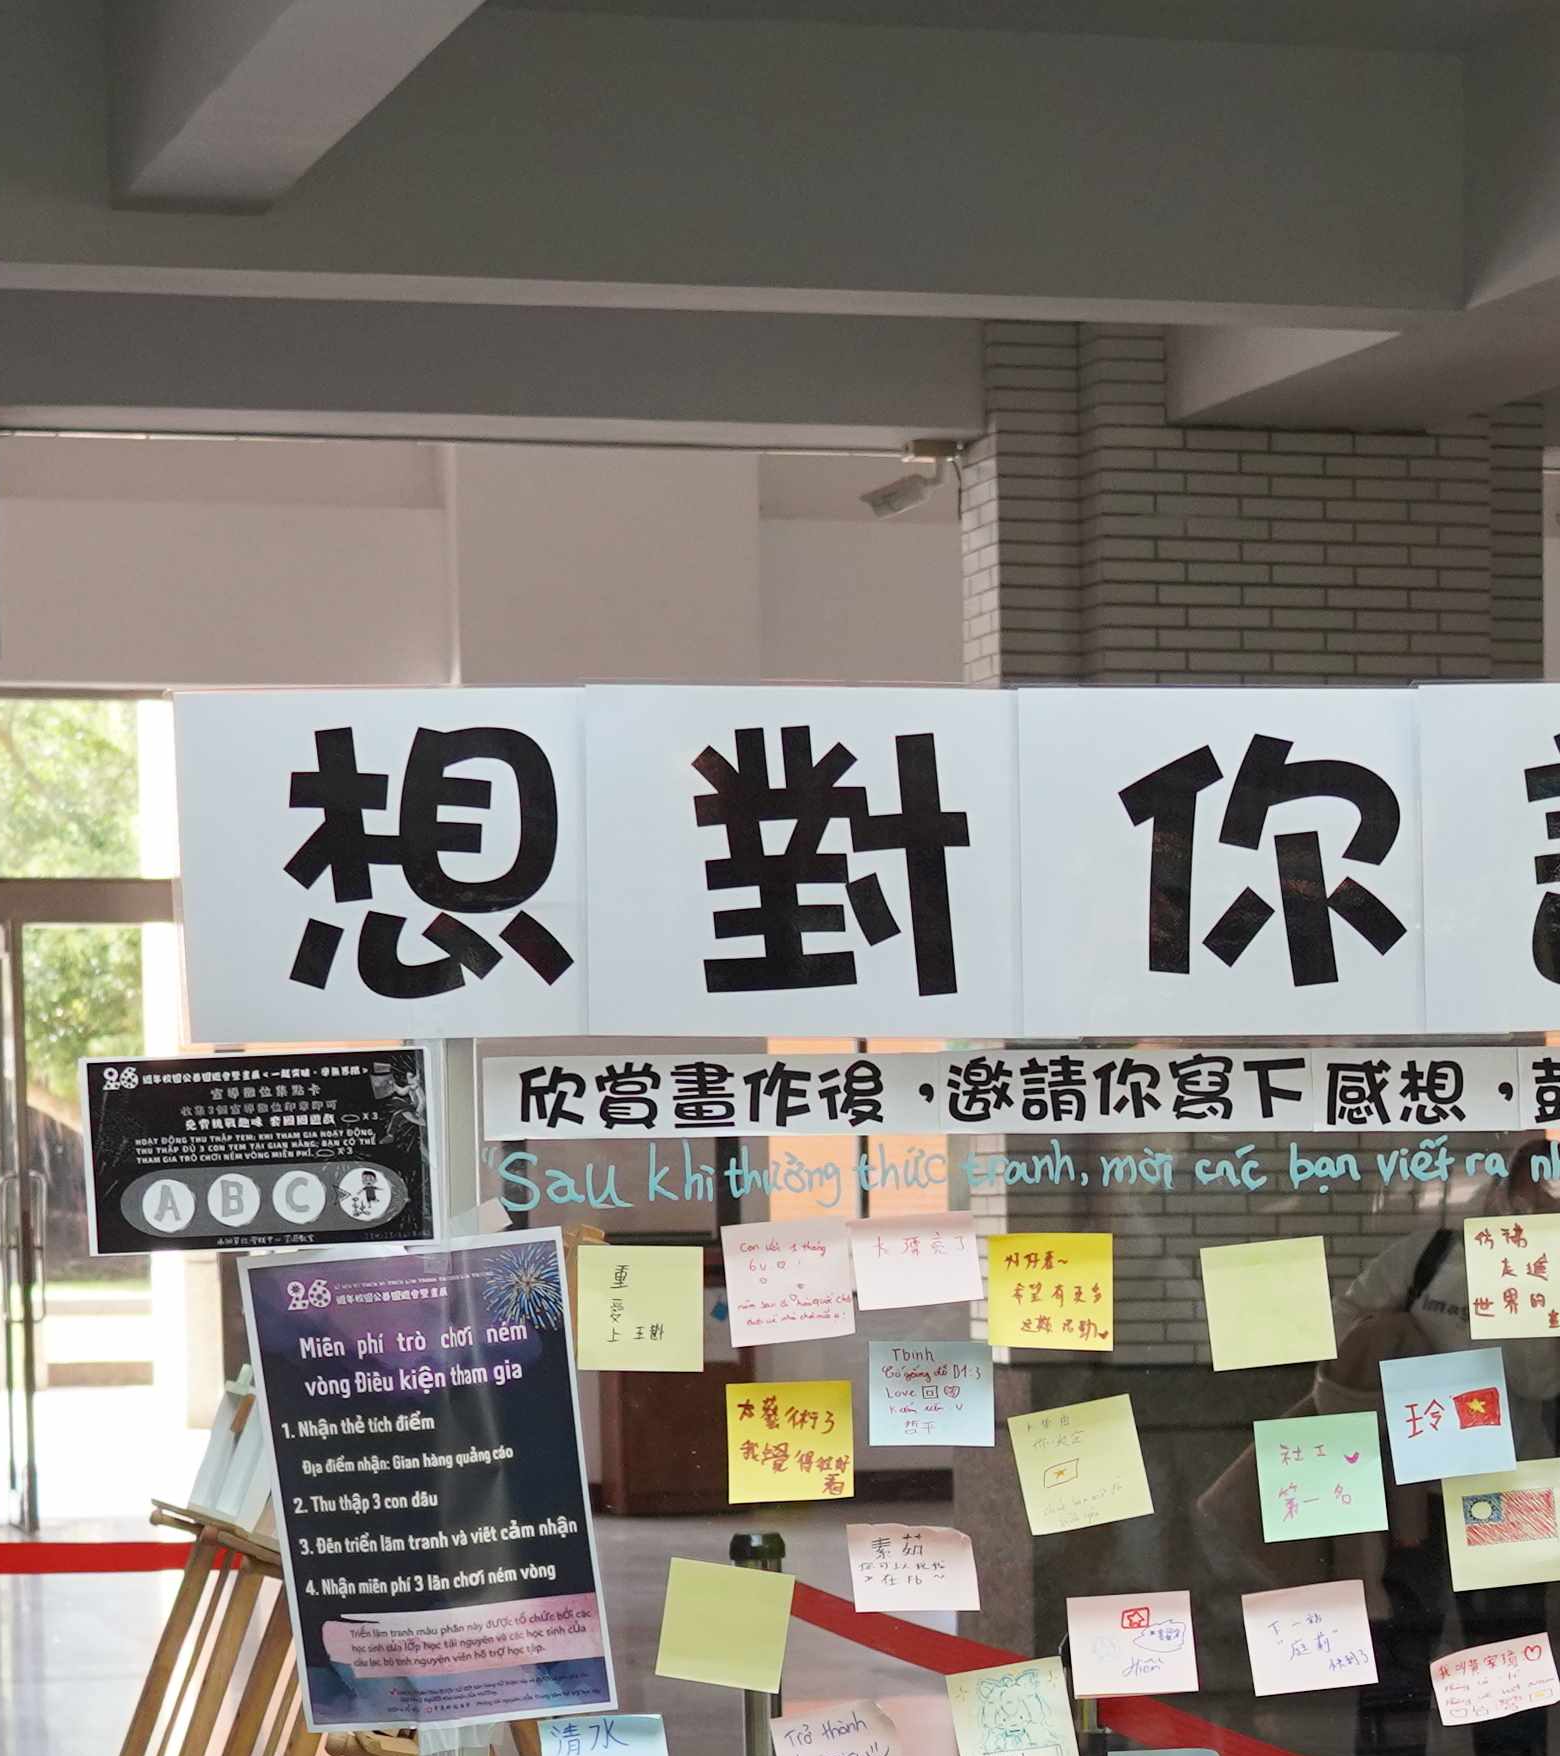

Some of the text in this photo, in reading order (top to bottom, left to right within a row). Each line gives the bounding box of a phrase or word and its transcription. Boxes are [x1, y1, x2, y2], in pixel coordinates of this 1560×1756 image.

[648, 1141, 716, 1202] khi
[154, 1184, 181, 1222] A
[221, 1179, 244, 1218] B
[285, 1176, 309, 1214] C
[396, 1330, 427, 1353] trò
[304, 1374, 351, 1399] vòng
[449, 1362, 489, 1386] tham
[493, 1359, 524, 1385] gia
[549, 1717, 630, 1756] 清水
